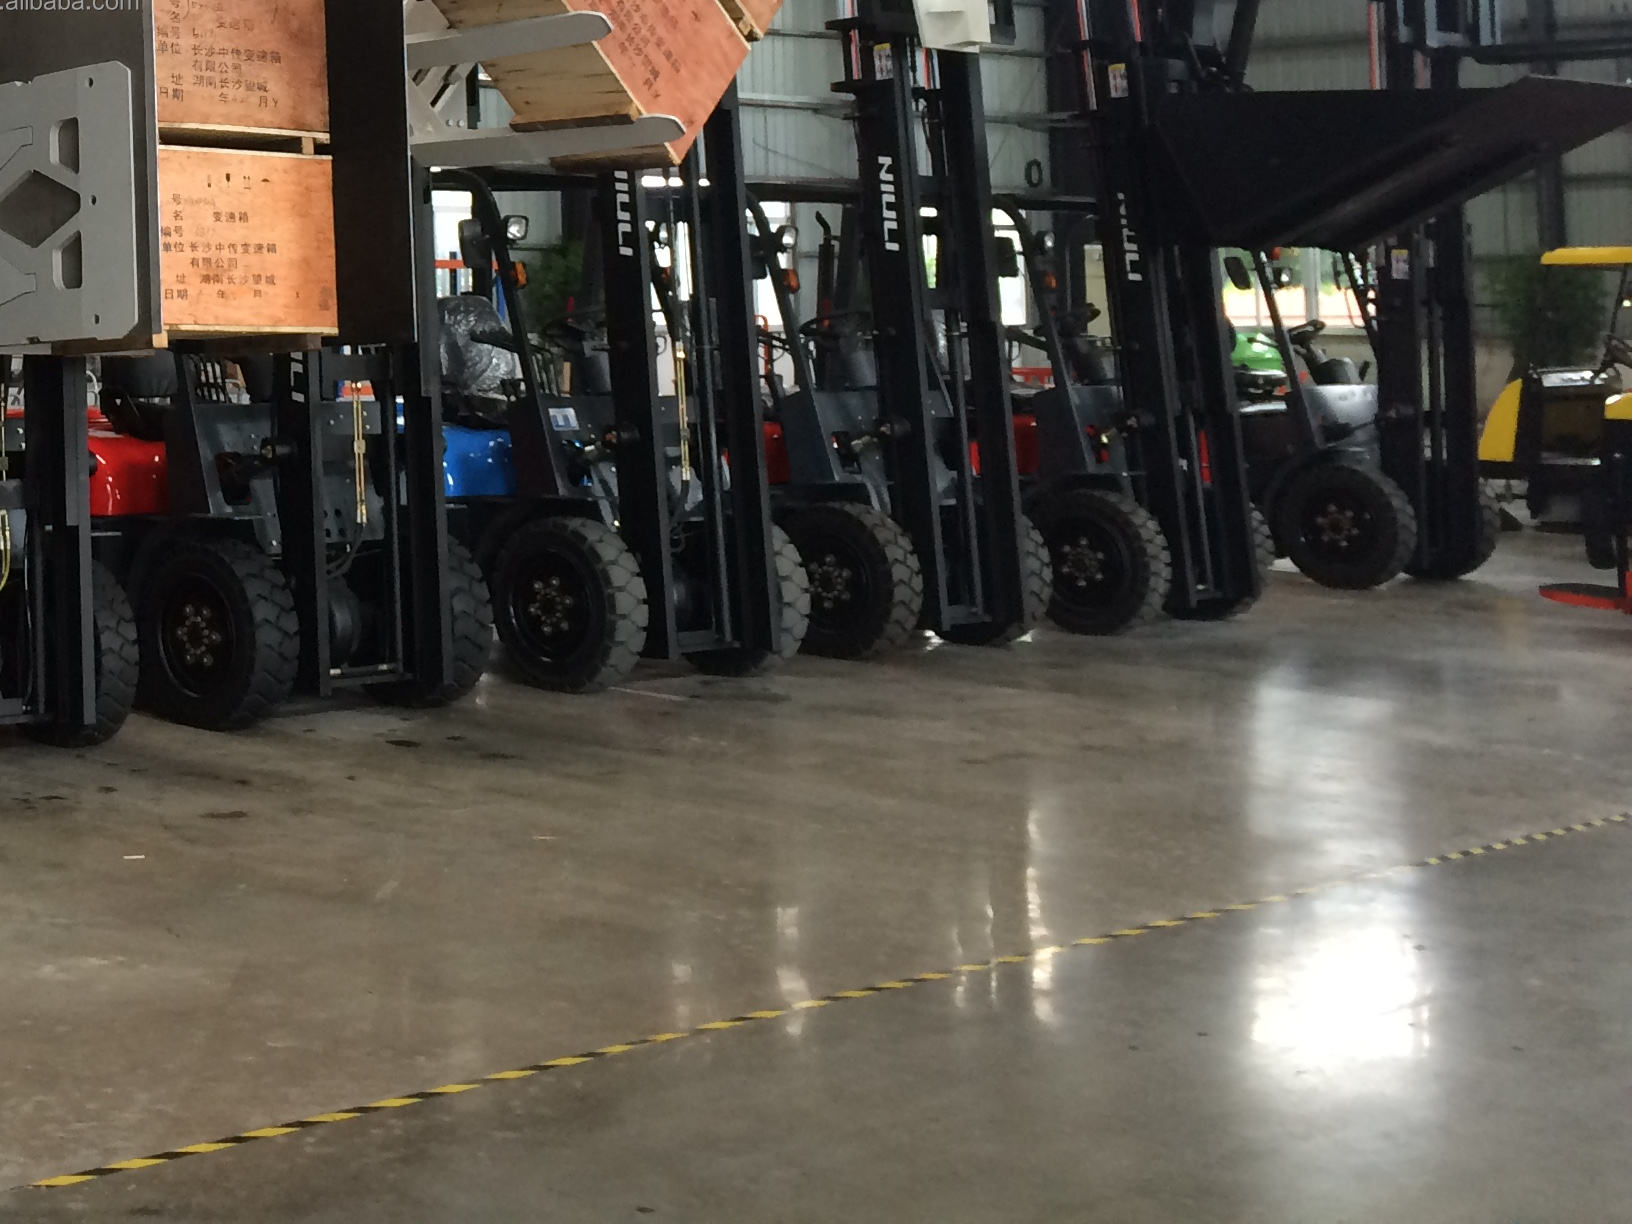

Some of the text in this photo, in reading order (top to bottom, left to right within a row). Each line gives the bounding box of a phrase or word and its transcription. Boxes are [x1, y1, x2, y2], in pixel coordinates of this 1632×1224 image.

[877, 155, 900, 252] NIULI
[190, 257, 238, 270] 有限公司
